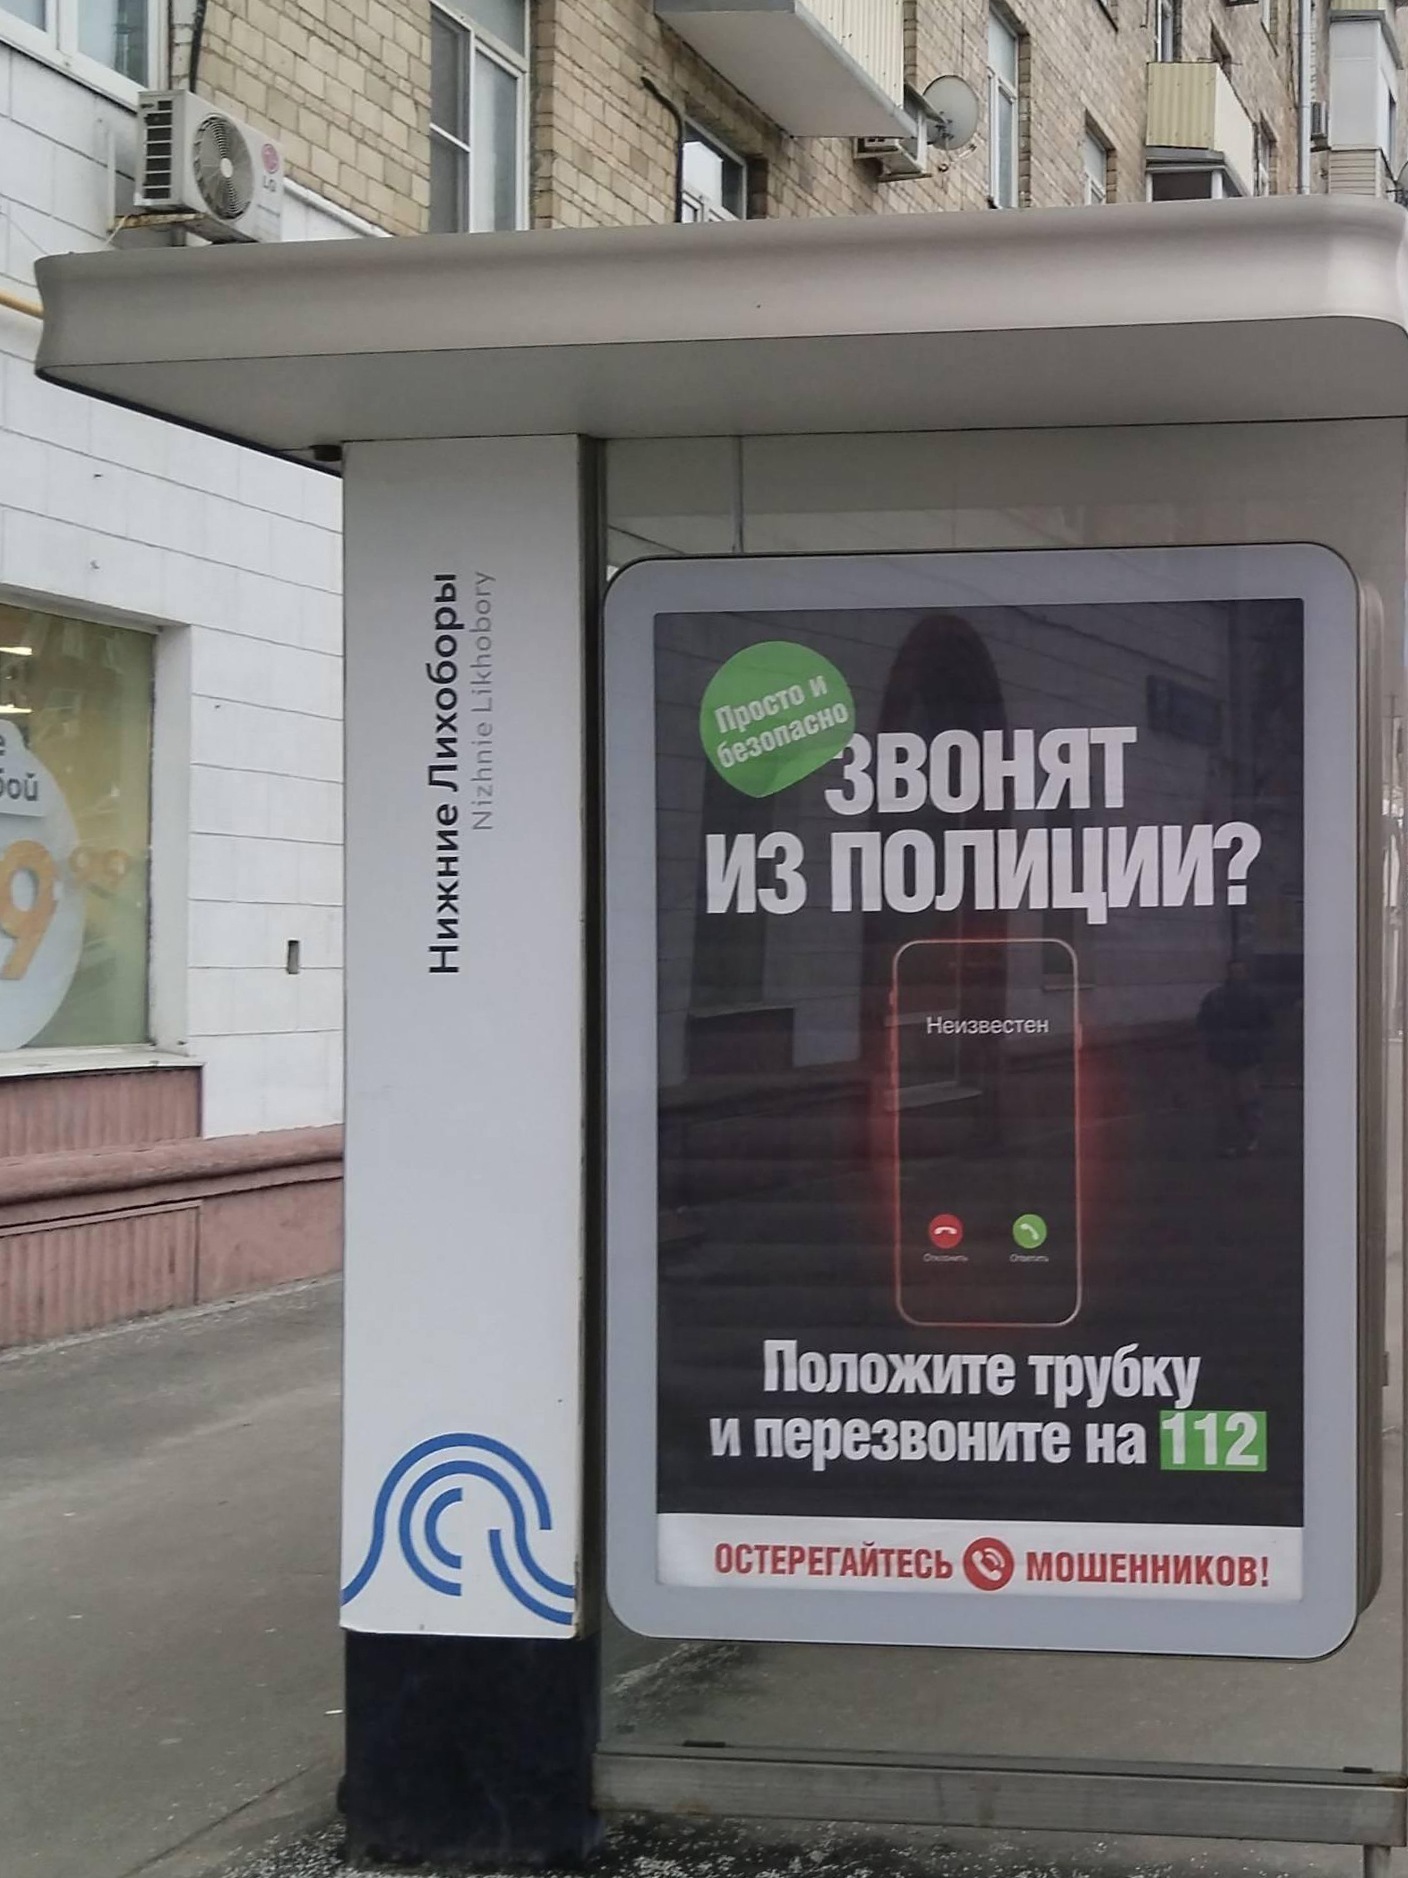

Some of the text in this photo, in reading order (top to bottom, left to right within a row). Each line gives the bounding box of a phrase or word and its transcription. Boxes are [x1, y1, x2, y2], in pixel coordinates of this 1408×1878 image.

[469, 571, 496, 830] Nizhnie Likhobory
[715, 675, 828, 733] Просто и
[716, 703, 849, 768] безопасно
[0, 768, 38, 801] ой
[425, 574, 465, 973] Нижние Лихоборы
[824, 726, 1137, 815] ЗВОНЯТ
[706, 821, 1262, 924] ИЗ ПОЛИЦИИ?
[926, 1015, 1049, 1035] Неизвестен
[763, 1339, 1201, 1408] Положите трубку
[710, 1411, 1261, 1471] и перезвоните на 112
[714, 1540, 1270, 1588] ОСТЕРЕГАЙТЕСЬ МОШЕННИКОВ!
